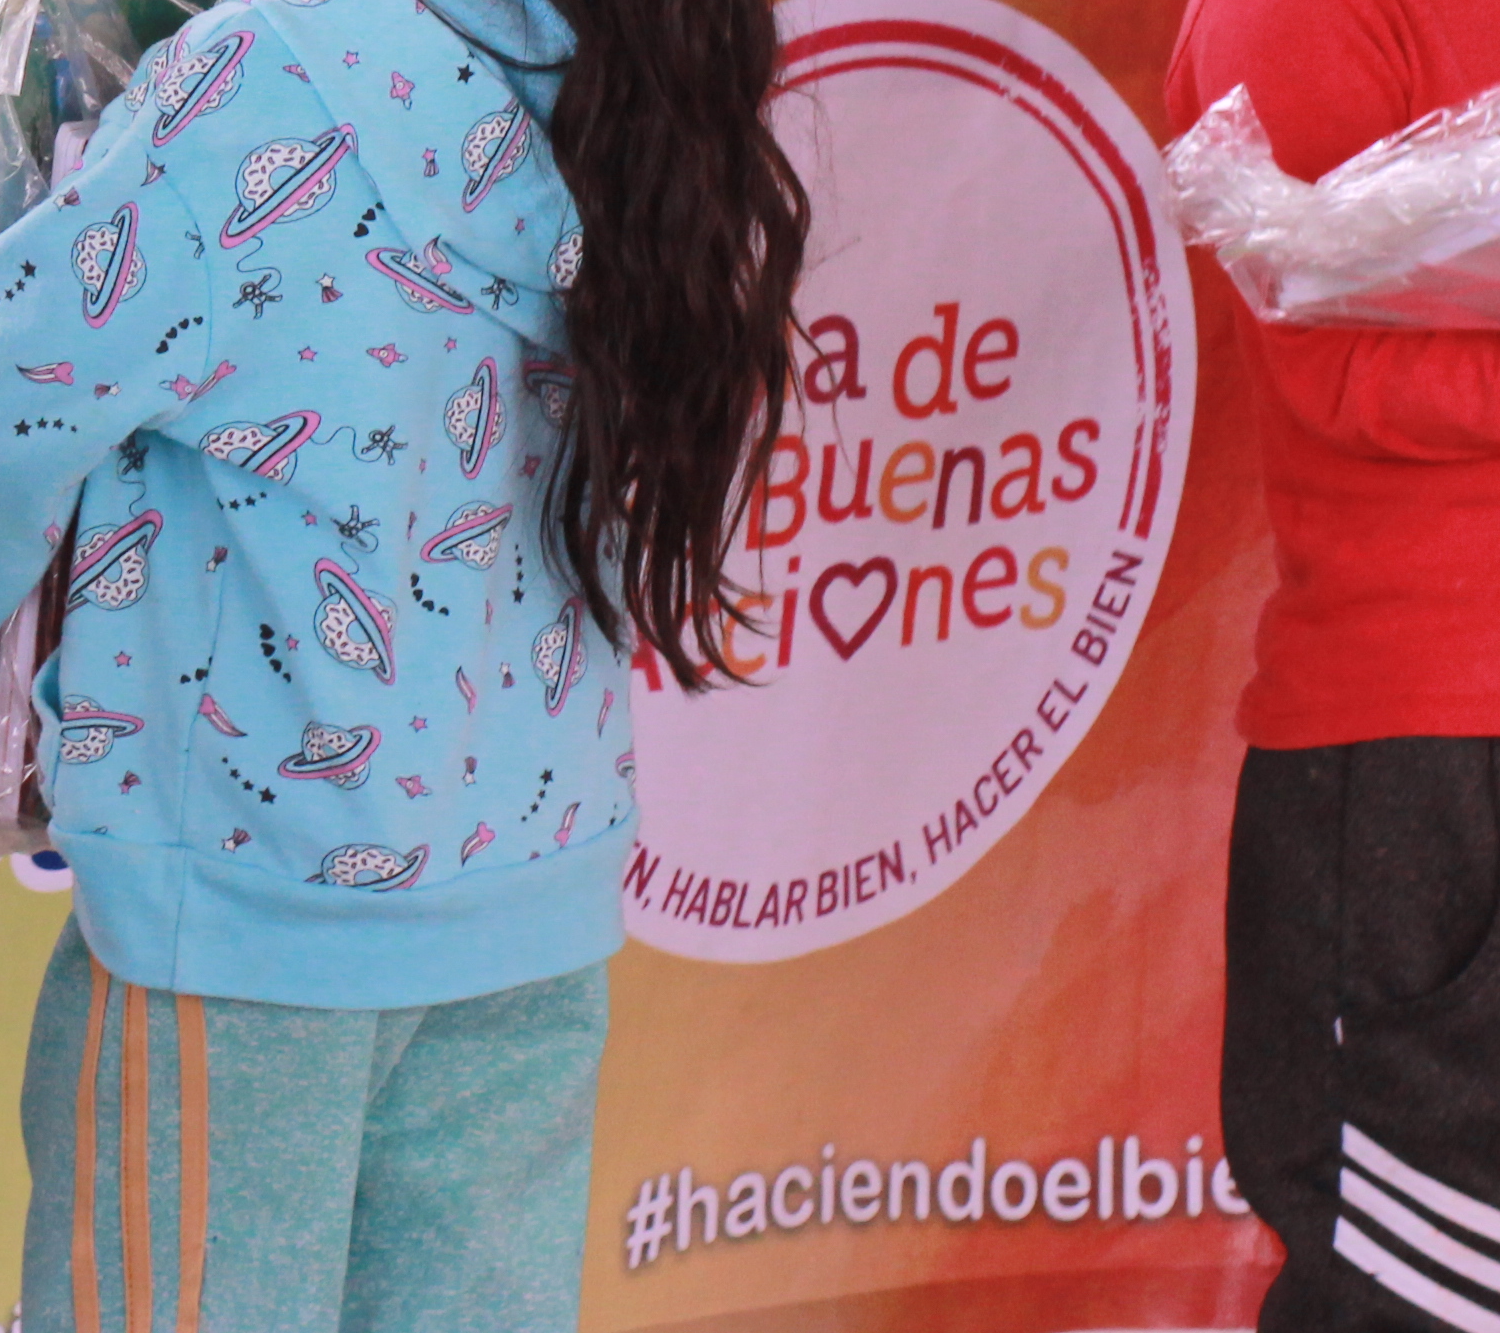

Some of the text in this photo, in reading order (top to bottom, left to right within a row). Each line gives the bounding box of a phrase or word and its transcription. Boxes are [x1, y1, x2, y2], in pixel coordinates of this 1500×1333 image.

[892, 303, 1019, 420] de
[745, 417, 1100, 551] Buenas
[623, 548, 1144, 929] N, HABLAR BIEN, HACER EL BIEN
[625, 1135, 1252, 1270] #haciendoelbie
